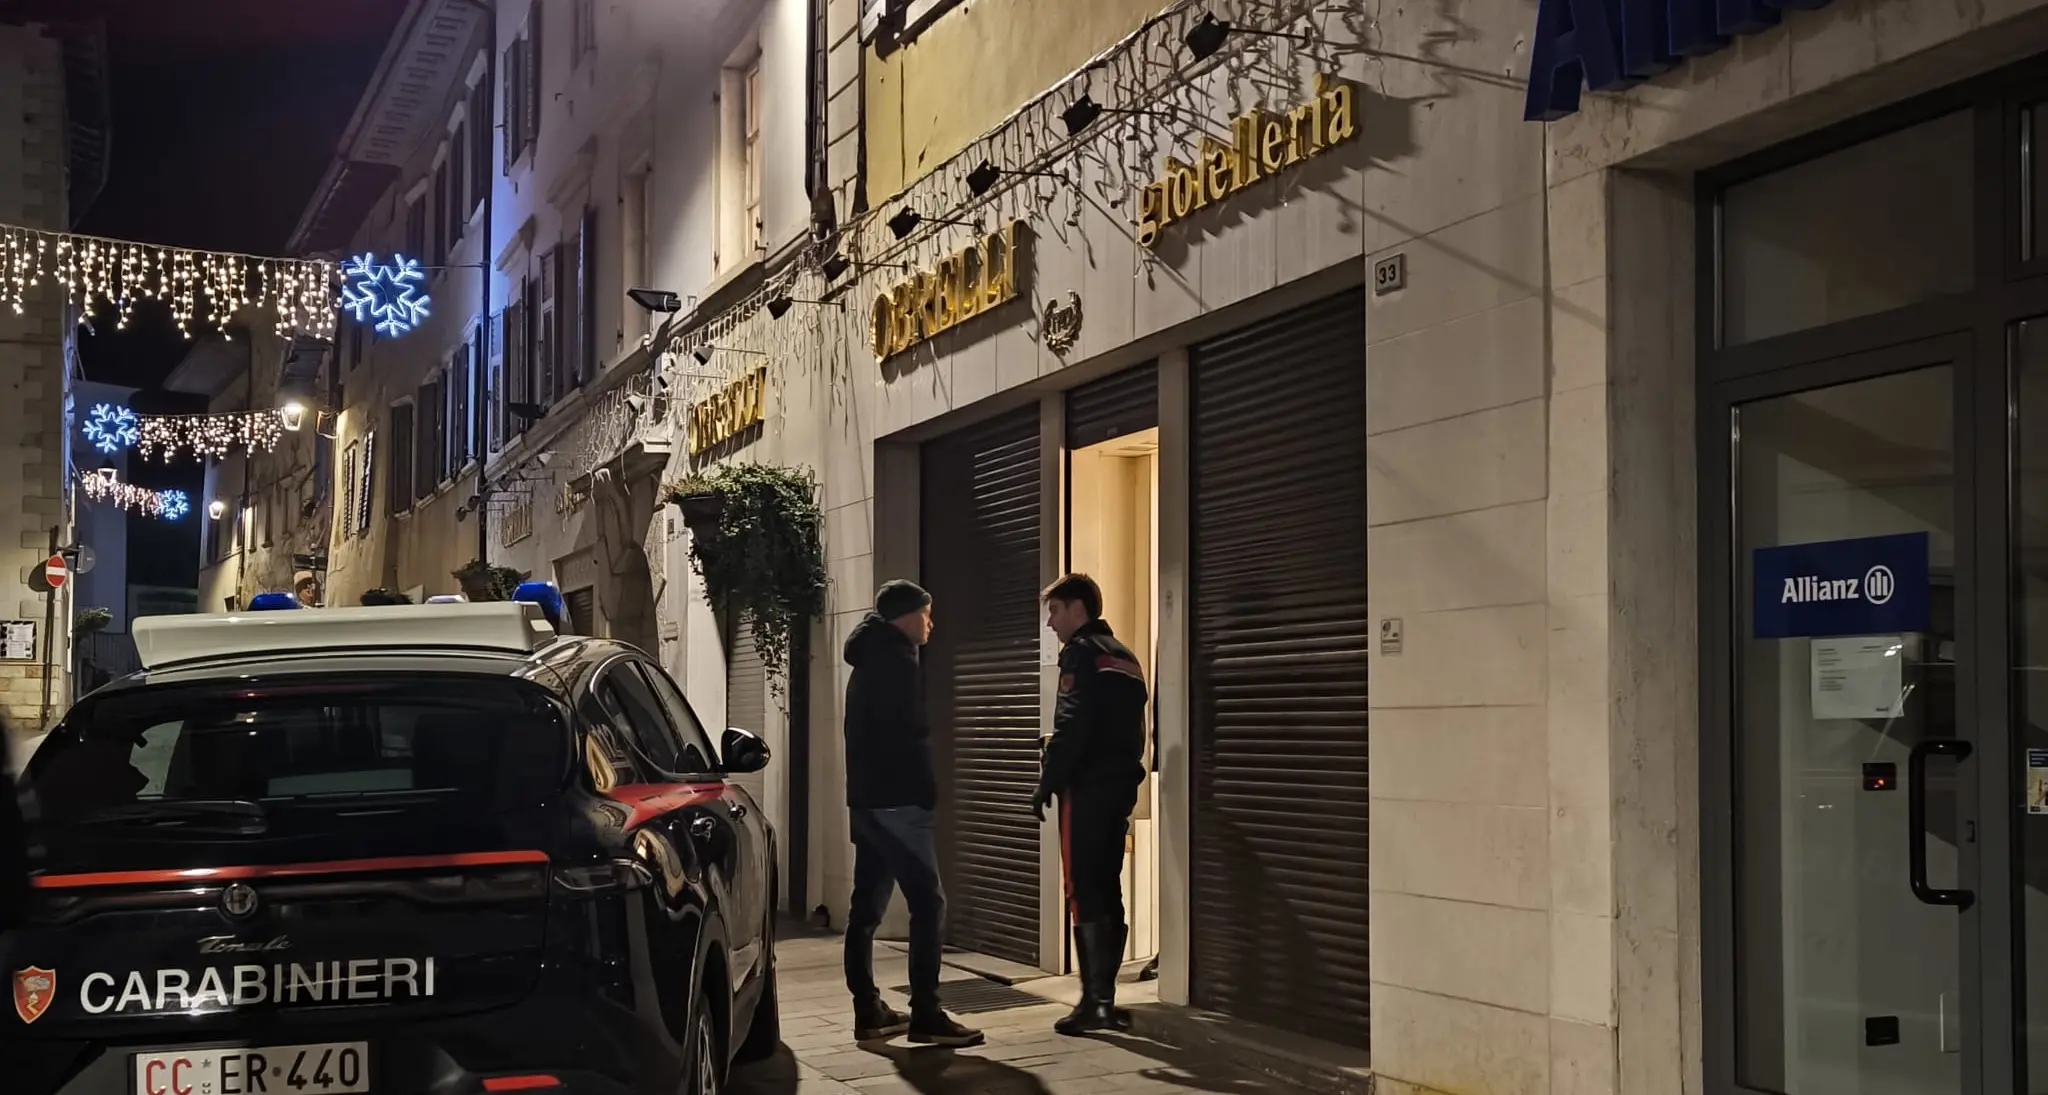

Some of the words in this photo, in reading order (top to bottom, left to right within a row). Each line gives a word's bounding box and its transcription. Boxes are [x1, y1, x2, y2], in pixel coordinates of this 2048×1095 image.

[1136, 72, 1355, 247] gioielleria
[870, 220, 1018, 364] OBRELLI
[1379, 264, 1396, 285] 33
[1780, 575, 1860, 604] Allianz
[80, 956, 435, 1014] CARABINIERI
[145, 1057, 193, 1095] CC
